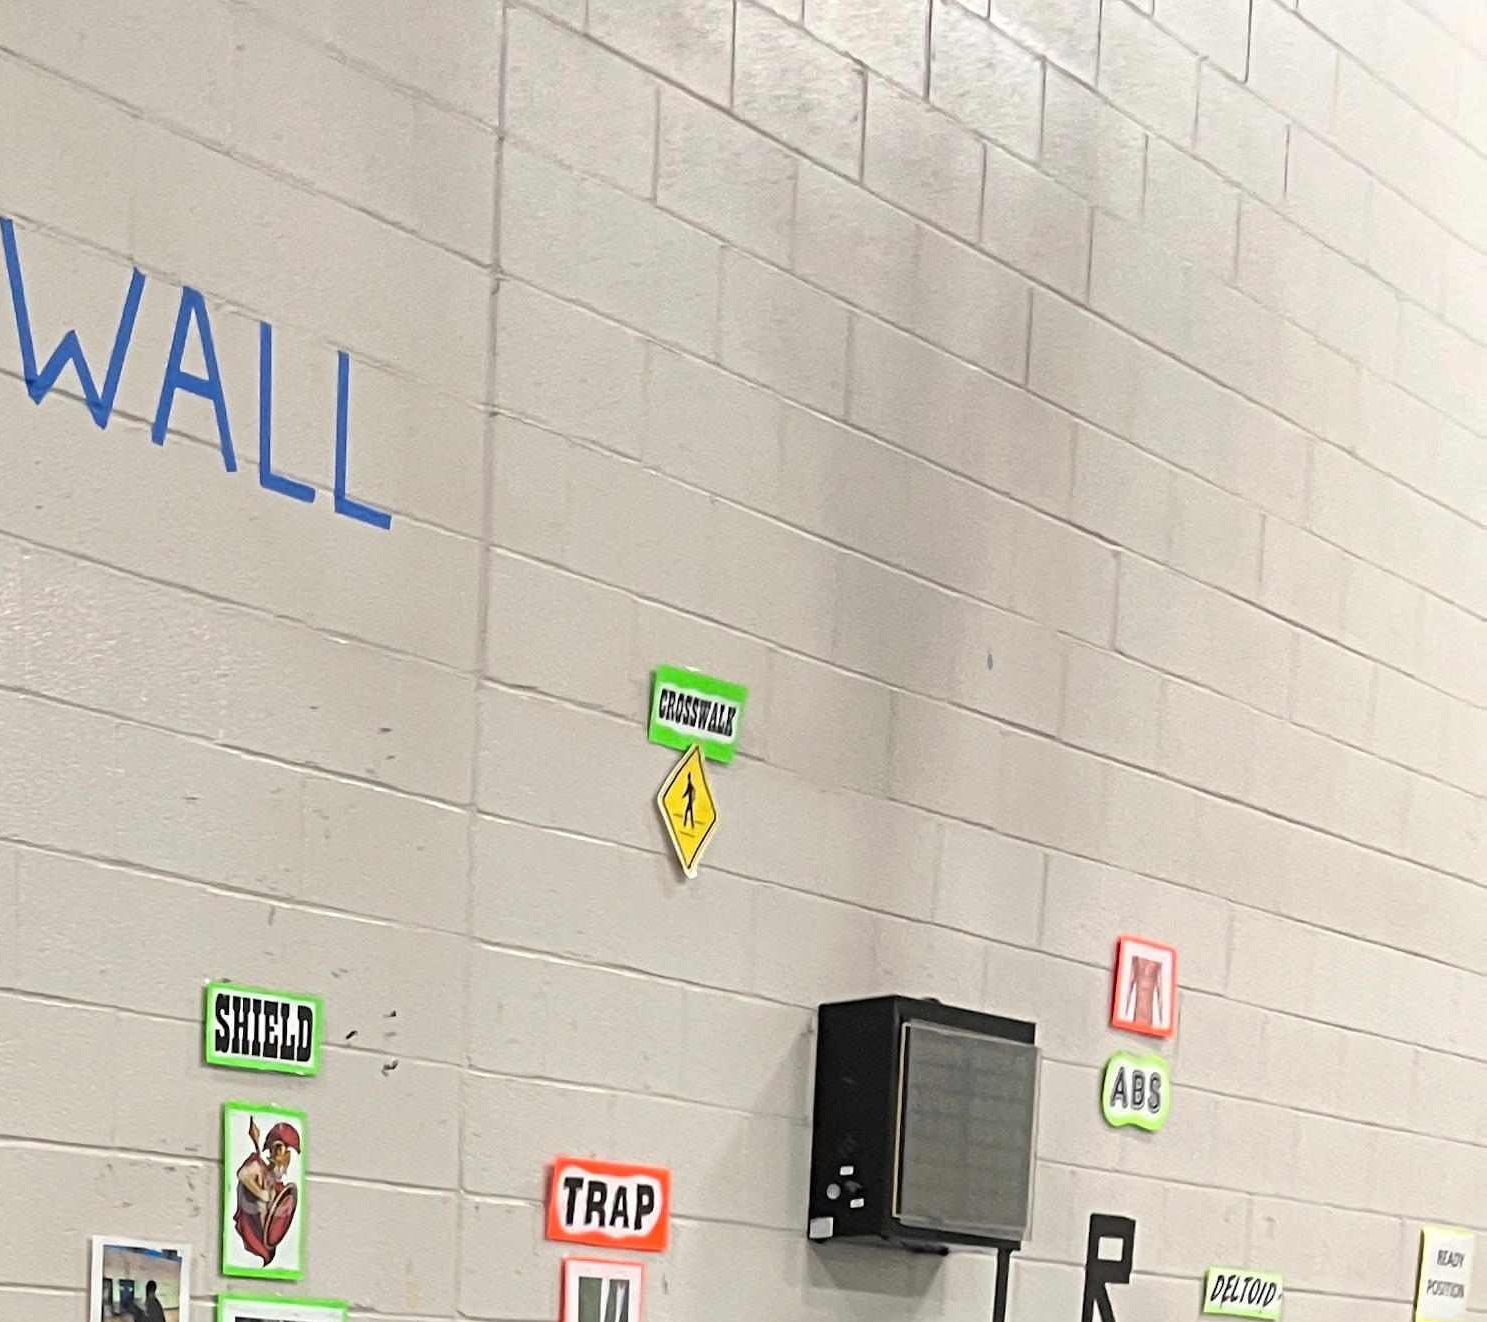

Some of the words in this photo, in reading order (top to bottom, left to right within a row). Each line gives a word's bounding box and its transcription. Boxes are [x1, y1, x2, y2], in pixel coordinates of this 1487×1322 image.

[0, 216, 391, 530] WALL
[658, 688, 736, 737] CROSSWALK
[214, 993, 314, 1063] SHIELD
[1111, 1066, 1163, 1115] ABS
[563, 1176, 655, 1231] TRAP
[1436, 1249, 1466, 1268] READY
[1212, 1274, 1278, 1308] DELTOID
